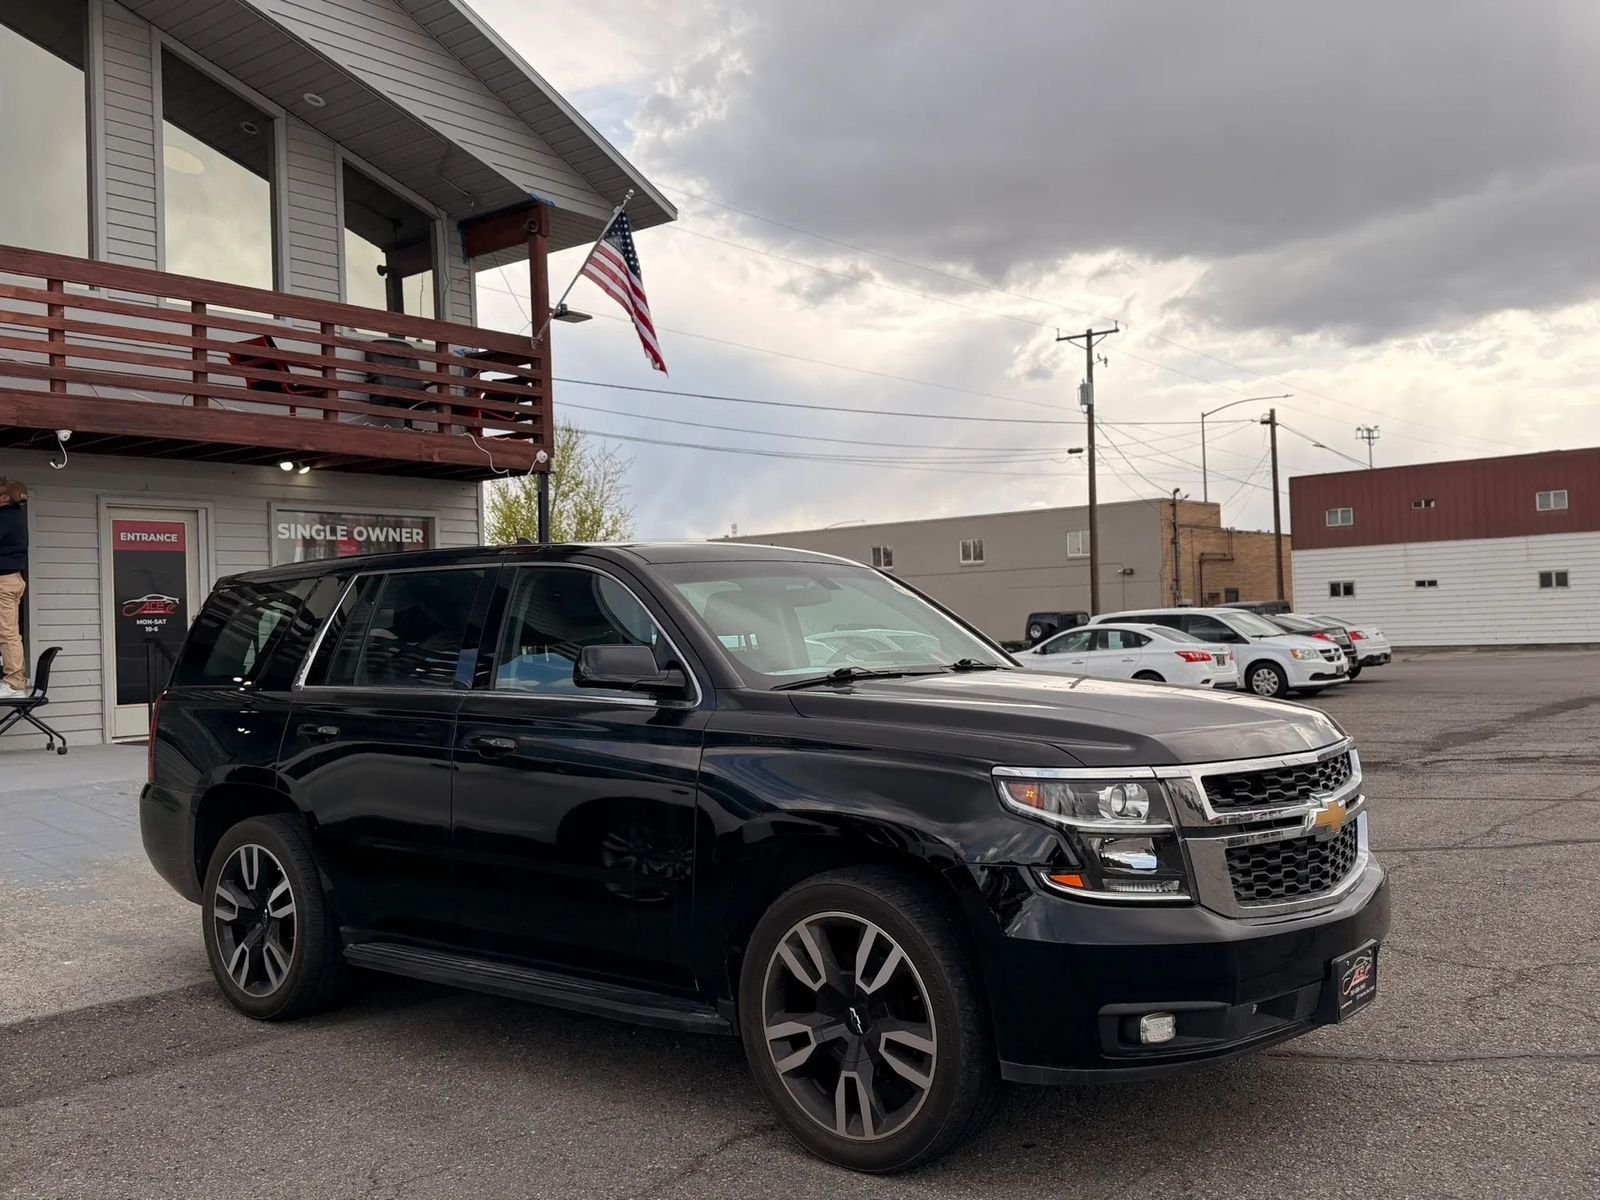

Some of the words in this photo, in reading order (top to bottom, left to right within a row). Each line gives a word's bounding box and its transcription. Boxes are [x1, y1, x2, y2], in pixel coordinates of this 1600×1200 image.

[120, 532, 178, 543] ENTRANCE
[277, 523, 348, 541] SINGLE
[353, 526, 424, 543] OWNER
